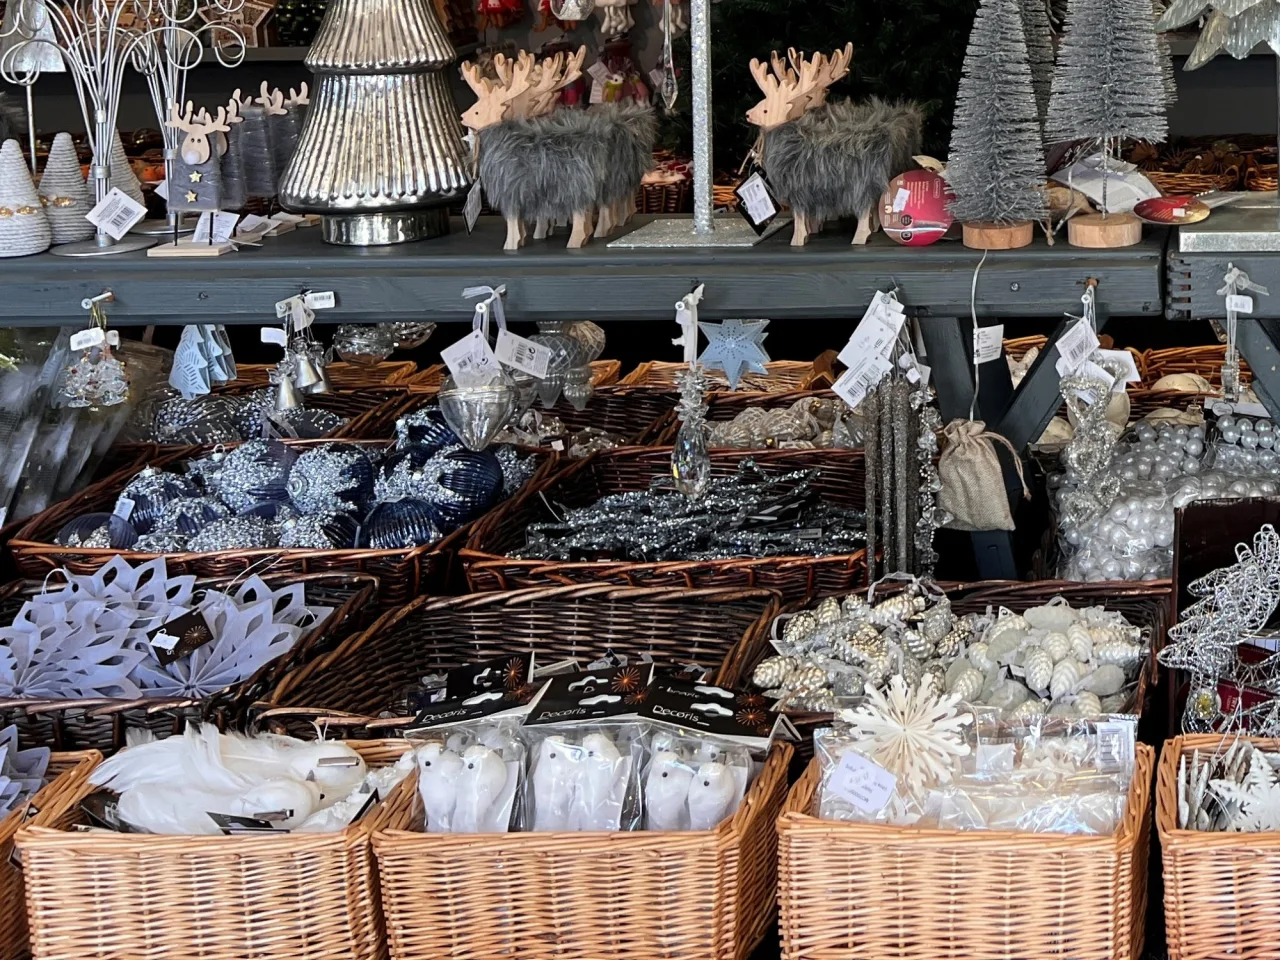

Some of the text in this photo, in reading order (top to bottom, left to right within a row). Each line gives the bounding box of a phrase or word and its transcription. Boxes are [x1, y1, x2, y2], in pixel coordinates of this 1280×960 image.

[420, 708, 468, 724] Decoris
[536, 707, 587, 721] Decoris
[652, 704, 700, 723] Decoris
